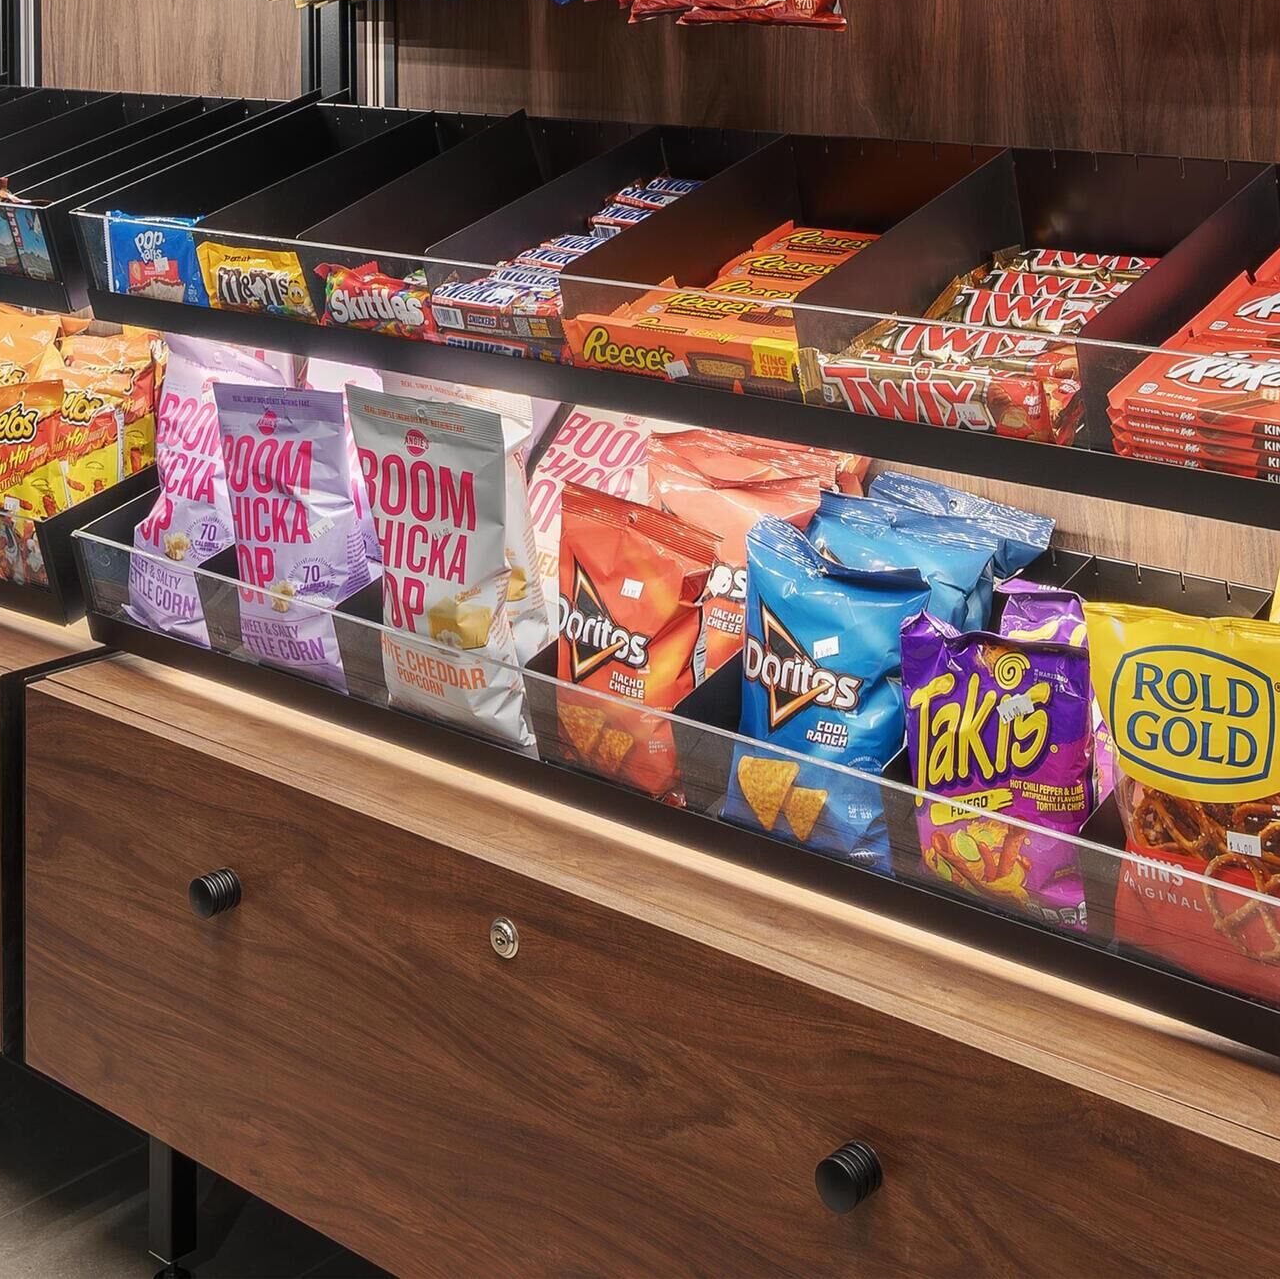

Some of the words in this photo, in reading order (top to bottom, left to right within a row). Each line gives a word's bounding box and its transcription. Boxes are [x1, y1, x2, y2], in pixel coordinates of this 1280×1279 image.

[743, 254, 837, 275] Reese's
[329, 289, 425, 326] Skittles
[663, 291, 758, 315] Reese's
[583, 327, 674, 372] Reese's
[759, 352, 787, 367] KING
[761, 365, 788, 378] SIZE
[202, 524, 217, 541] 70
[376, 519, 469, 584] HICKA
[156, 571, 181, 589] SALTY
[155, 590, 198, 618] CORN
[559, 601, 650, 667] Doritos
[397, 667, 445, 698] POPCORN
[406, 650, 488, 691] CHEDDAR
[612, 671, 645, 689] NACHO
[746, 639, 864, 707] Doritos
[609, 679, 645, 699] CHEESE
[1132, 657, 1260, 716] ROLD
[806, 729, 849, 747] RANCH
[816, 720, 849, 735] COOL
[1127, 709, 1258, 768] GOLD
[910, 673, 1051, 808] Takis
[1010, 780, 1021, 789] HOT
[1023, 782, 1039, 791] CHILI
[1039, 784, 1063, 795] PEPPER
[1071, 784, 1083, 795] LIME
[1022, 791, 1057, 802] ARTIFICIALLY
[1058, 793, 1085, 802] FLAVORED
[1036, 801, 1067, 811] TORTILLA
[1068, 801, 1085, 810] CHIPS
[1124, 870, 1203, 912] ORIGINAL
